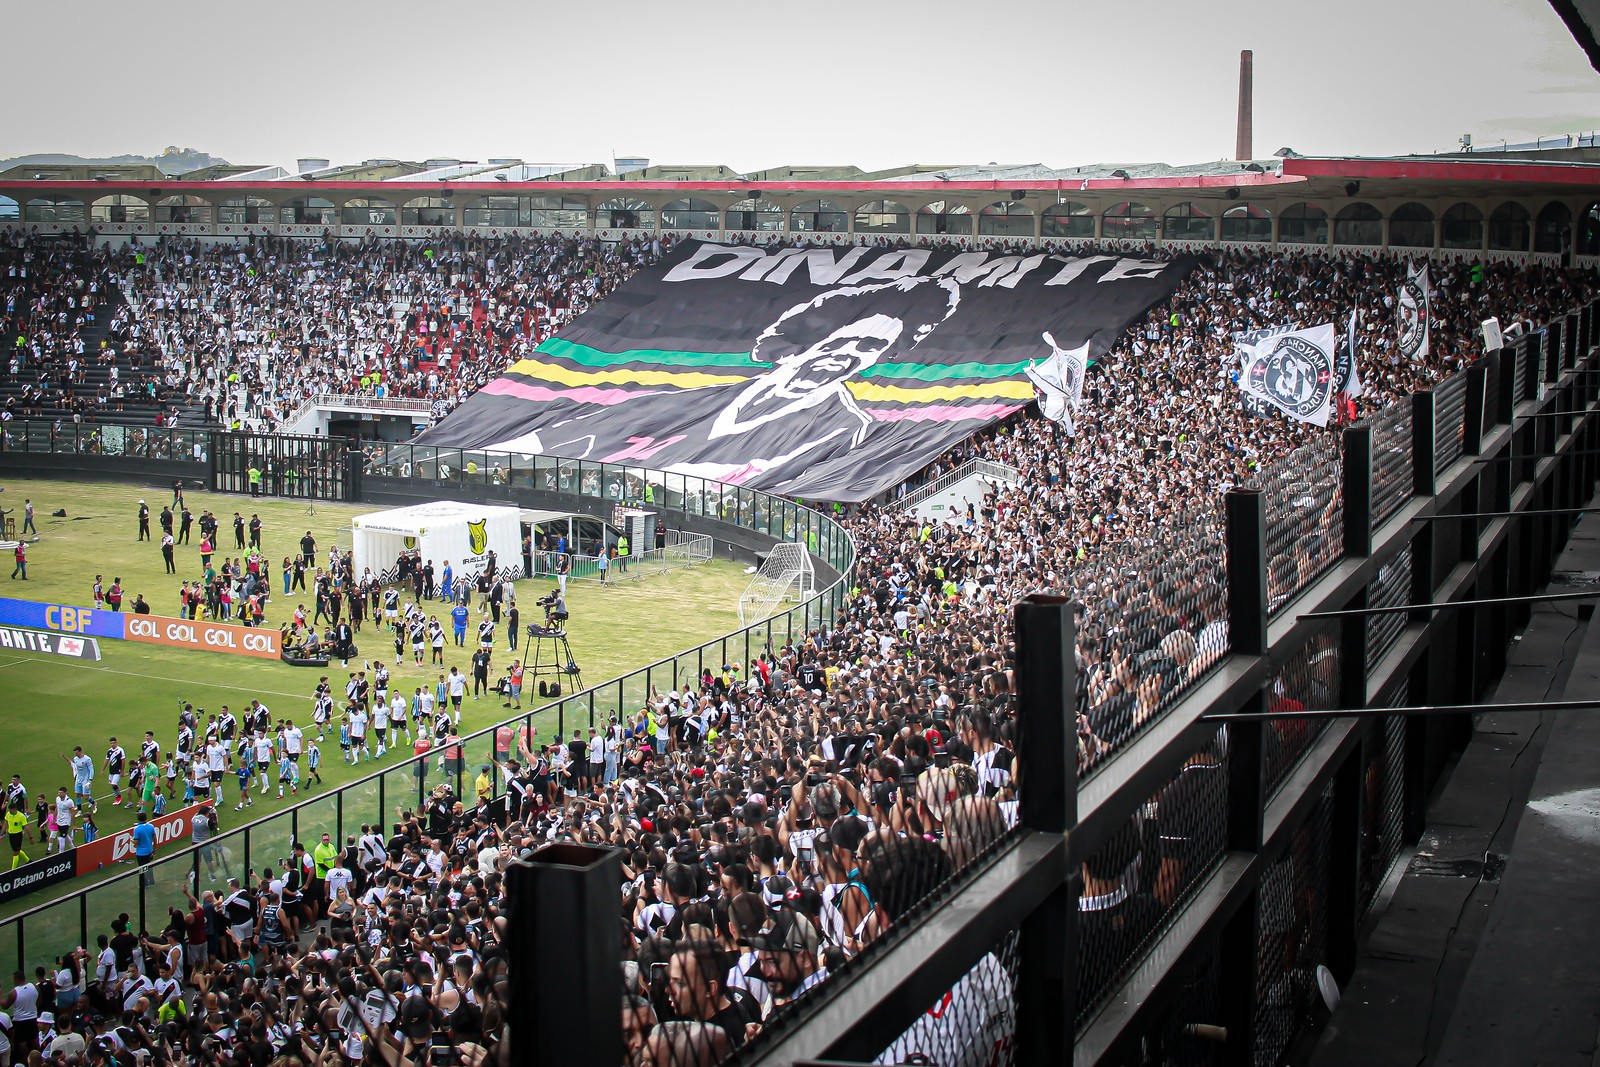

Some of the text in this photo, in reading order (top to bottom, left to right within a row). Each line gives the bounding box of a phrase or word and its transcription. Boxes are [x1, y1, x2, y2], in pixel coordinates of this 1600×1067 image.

[661, 243, 1170, 289] DINAMITE
[45, 606, 92, 632] CBF
[0, 629, 52, 652] ANTE
[129, 619, 275, 653] GOL GOL GOL GOL
[804, 673, 814, 684] 10
[13, 871, 45, 889] Betano
[46, 861, 72, 878] 2024
